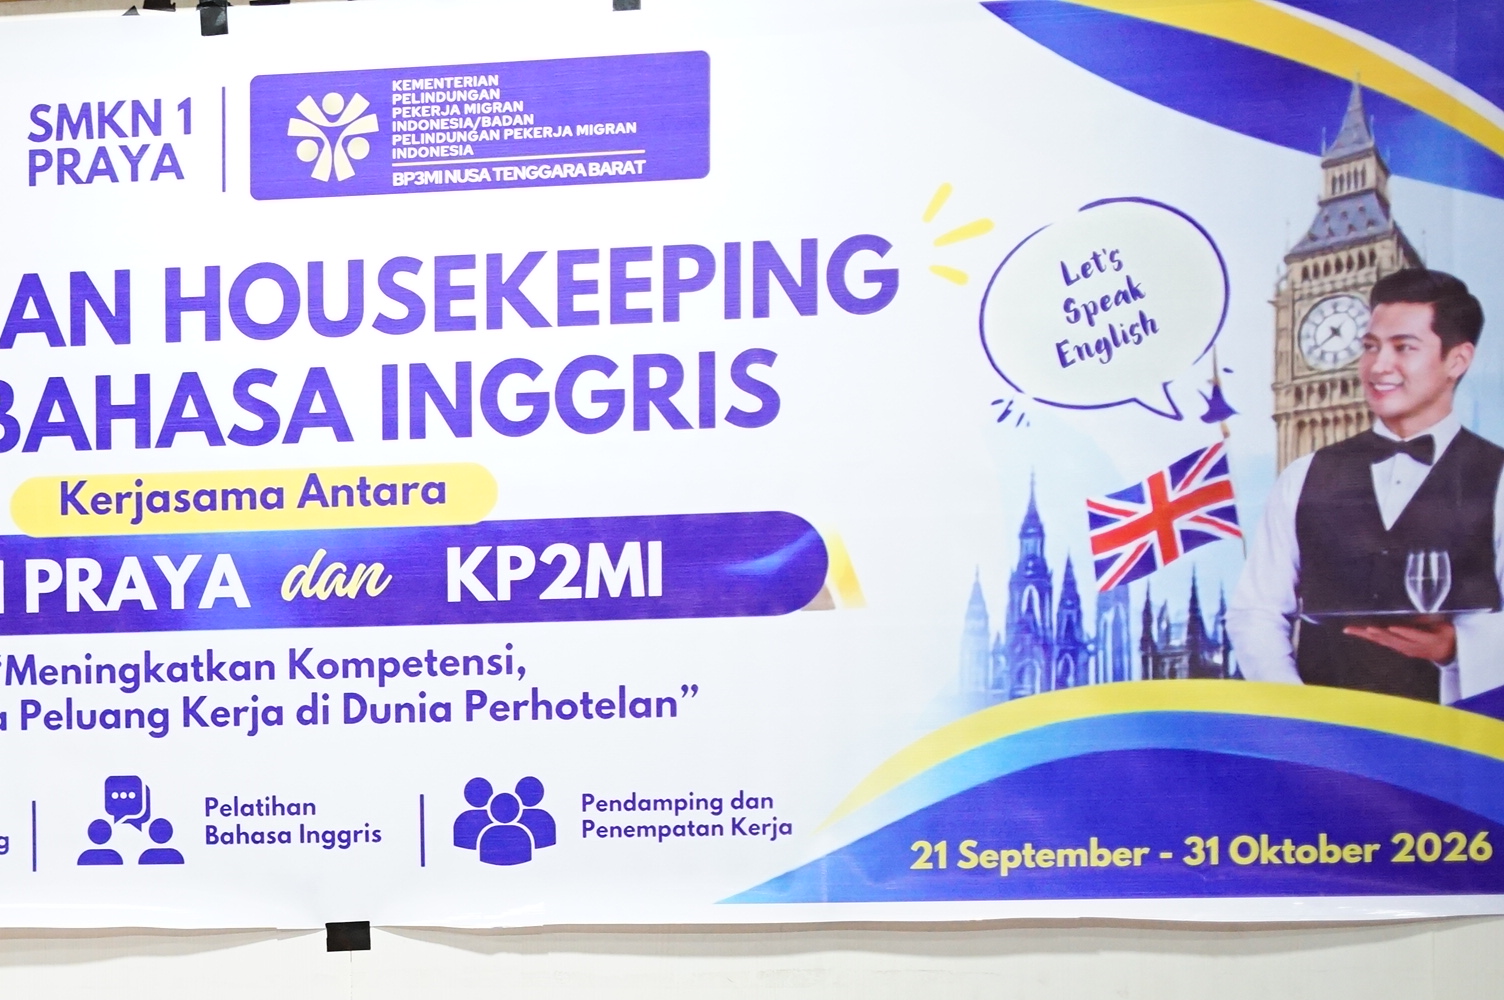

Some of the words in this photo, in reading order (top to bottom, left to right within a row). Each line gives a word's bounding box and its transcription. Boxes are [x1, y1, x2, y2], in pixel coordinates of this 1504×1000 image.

[392, 75, 499, 91] KEMENTERIAN
[392, 88, 501, 105] PELINDUNGAN
[27, 98, 162, 143] SMKN
[177, 96, 192, 135] 1
[392, 104, 461, 118] PEKERJA
[464, 101, 524, 115] MIGRAN
[392, 113, 535, 132] INDONESIA/BADAN
[392, 129, 500, 146] PELINDUNGAN
[503, 125, 573, 140] PEKERJA
[576, 121, 637, 136] MIGRAN
[392, 144, 475, 159] INDONESIA
[28, 142, 185, 187] PRAYA
[392, 169, 443, 186] BP3MI
[445, 167, 492, 184] NUSA
[492, 162, 587, 182] TENGGARA
[588, 159, 646, 177] BARAT
[1059, 248, 1124, 287] Let's
[164, 233, 899, 344] HOUSEKEEPING
[1062, 274, 1146, 327] Speak
[1055, 309, 1160, 369] English
[381, 347, 781, 441] INGGRIS
[60, 478, 284, 526] Kerjasama
[296, 472, 446, 509] Antara
[25, 552, 252, 614] PRAYA
[280, 547, 394, 602] dan
[446, 540, 663, 603] KP2MI
[288, 642, 526, 688] Kompetensi,
[20, 696, 170, 739] Peluang
[182, 694, 284, 737] Kerja
[295, 691, 330, 726] di
[343, 690, 452, 725] Dunia
[465, 683, 699, 722] Perhotelan”
[205, 795, 316, 818] Pelatihan
[581, 791, 723, 817] Pendamping
[730, 789, 774, 810] dan
[205, 823, 292, 846] Bahasa
[299, 823, 382, 850] Inggris
[582, 819, 724, 843] Penempatan
[731, 816, 793, 842] Kerja
[909, 839, 948, 871] 21
[956, 836, 1151, 878] September
[1182, 835, 1219, 866] 31
[1228, 832, 1381, 866] Oktober
[1391, 831, 1493, 863] 2026
